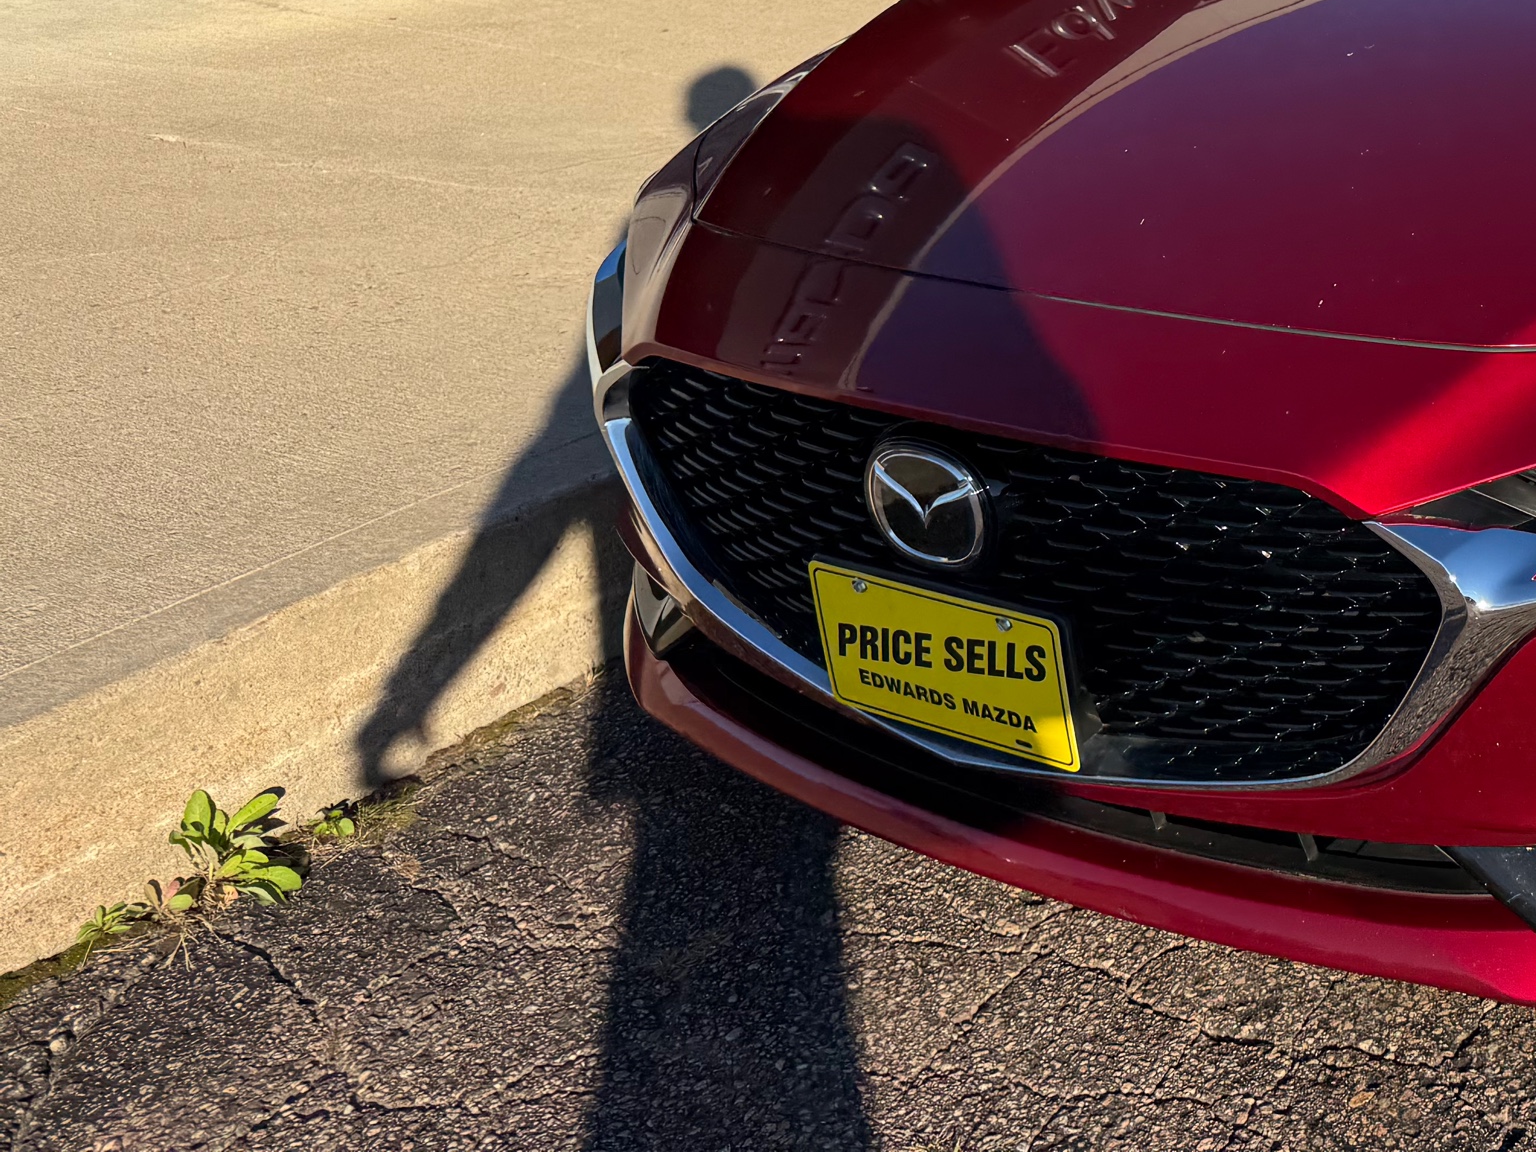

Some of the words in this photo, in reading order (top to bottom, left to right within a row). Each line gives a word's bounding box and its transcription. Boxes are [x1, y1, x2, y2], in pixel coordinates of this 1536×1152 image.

[838, 622, 933, 669] PRICE
[943, 635, 1047, 682] SELLS
[858, 668, 957, 711] EDWARDS
[962, 698, 1038, 734] MAZDA
